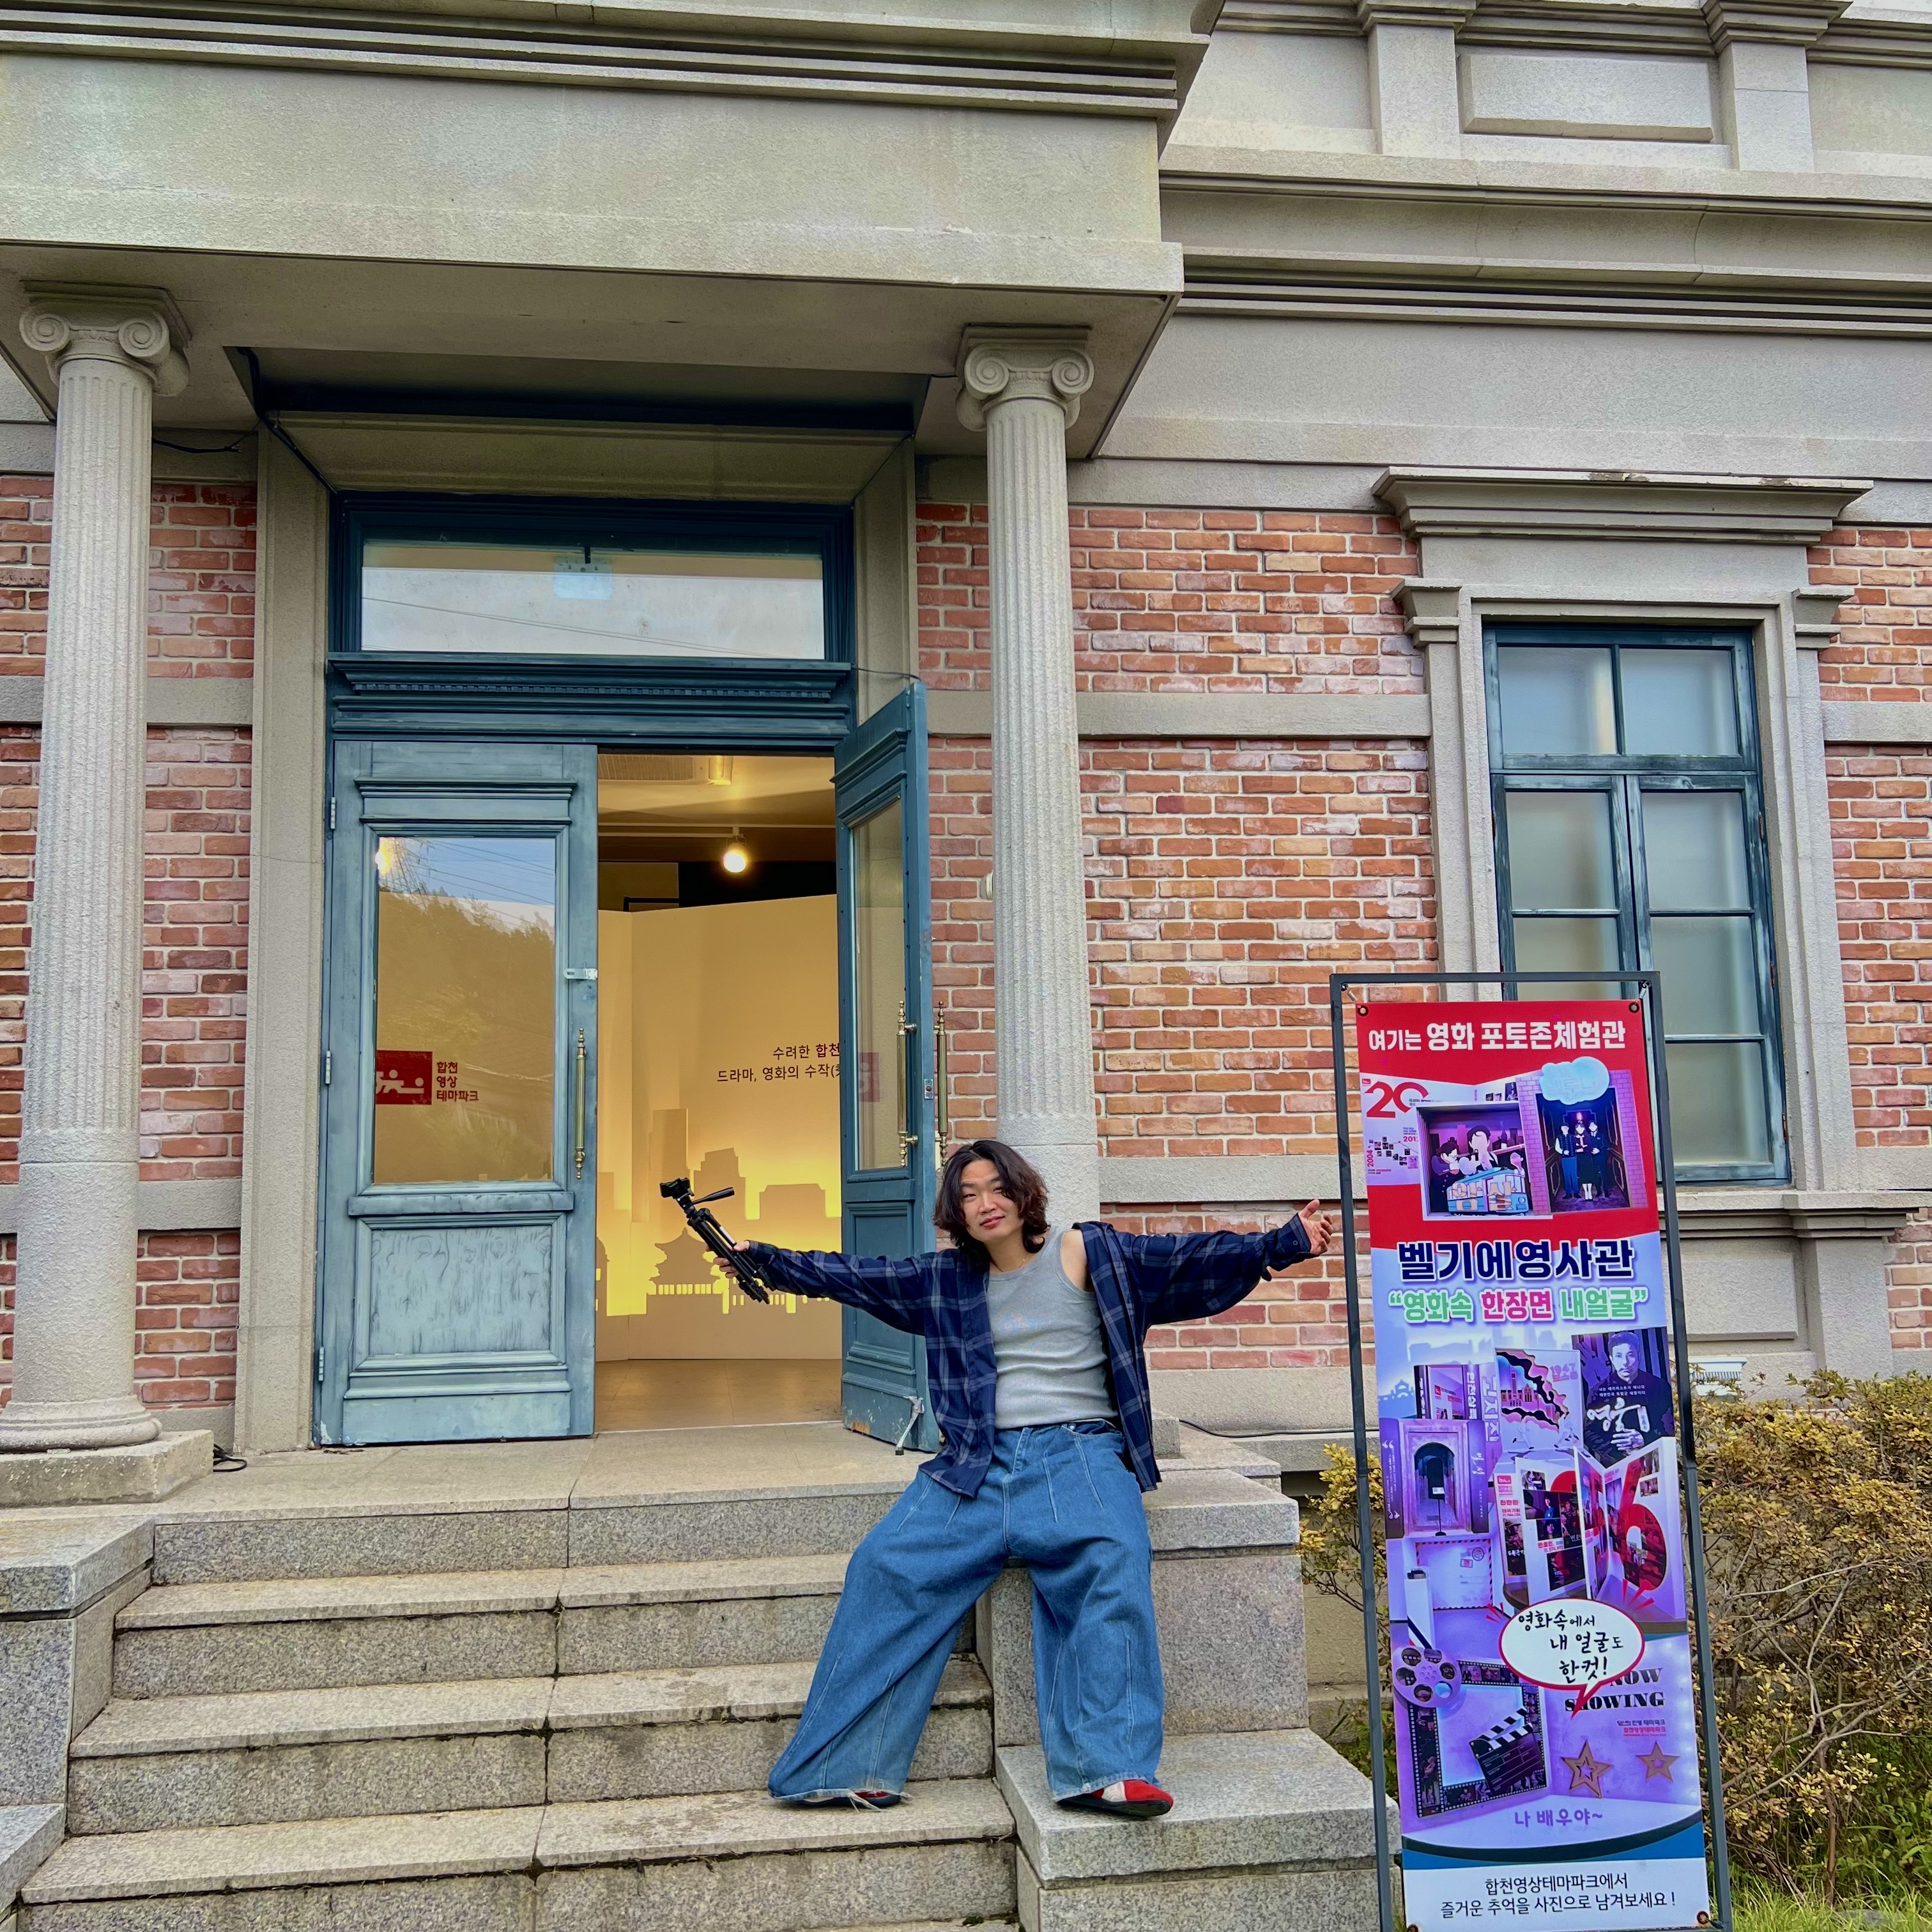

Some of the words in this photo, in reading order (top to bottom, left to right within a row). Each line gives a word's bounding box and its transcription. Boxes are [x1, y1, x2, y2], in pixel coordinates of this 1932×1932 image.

[1368, 1029, 1422, 1051] 여기는
[1427, 1022, 1475, 1051] 영화
[1481, 1020, 1626, 1050] 포토존체험관
[772, 1045, 810, 1061] 수려한
[815, 1042, 840, 1057] 합천
[436, 1061, 458, 1074] 합천
[717, 1068, 757, 1082] 드라마,
[762, 1065, 799, 1080] 영화의
[436, 1076, 457, 1088] 영상
[436, 1090, 479, 1102] 테마파크
[1397, 1239, 1634, 1280] 벨기에영사관
[1389, 1289, 1473, 1321] “영화속
[1481, 1288, 1552, 1319] 한장면
[1561, 1287, 1646, 1319] 내얼굴”
[1518, 1609, 1595, 1631] 영화속에서
[1550, 1634, 1567, 1650] 내
[1559, 1656, 1607, 1683] 한컷!
[1514, 1811, 1531, 1828] 나
[1537, 1808, 1603, 1827] 배우야~
[1485, 1873, 1629, 1896] 합천영상테마파크에서
[1441, 1900, 1483, 1919] 즐거운
[1487, 1897, 1530, 1915] 추억을
[1534, 1895, 1592, 1913] 사진으로
